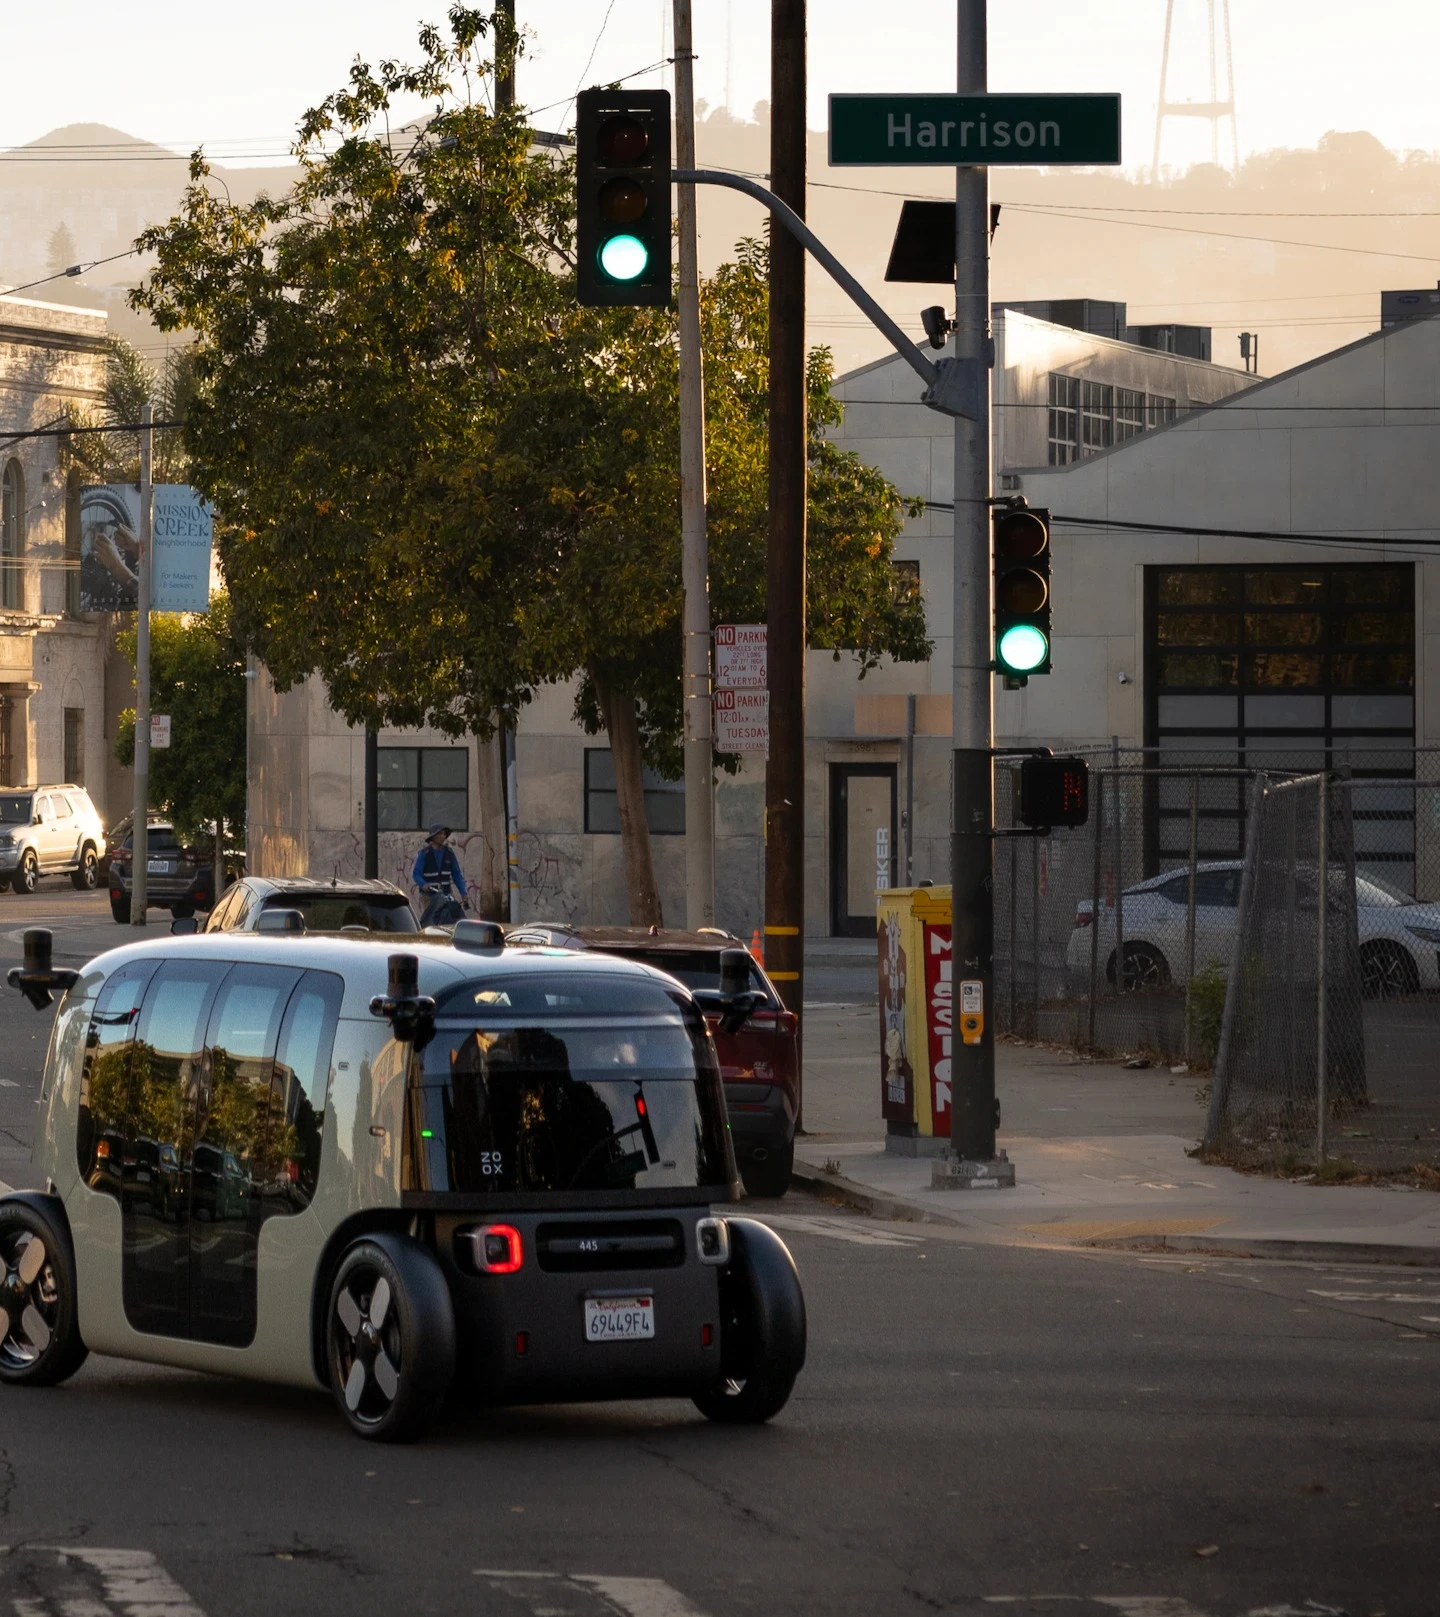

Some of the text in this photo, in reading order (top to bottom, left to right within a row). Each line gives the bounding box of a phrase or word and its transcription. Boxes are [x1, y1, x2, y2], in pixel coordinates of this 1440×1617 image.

[887, 112, 1061, 147] Harrison
[156, 505, 210, 521] MISSION
[155, 518, 209, 537] CREEK
[155, 538, 207, 548] Neighborhood
[173, 572, 198, 580] Makers
[169, 581, 194, 589] Seekers
[718, 627, 768, 644] NO PARKIN
[726, 677, 767, 685] EVERYDAY
[717, 692, 766, 708] NO PARKIN
[727, 728, 766, 738] TUESDAY
[579, 1240, 598, 1251] 445
[591, 1311, 650, 1334] 69449F4
